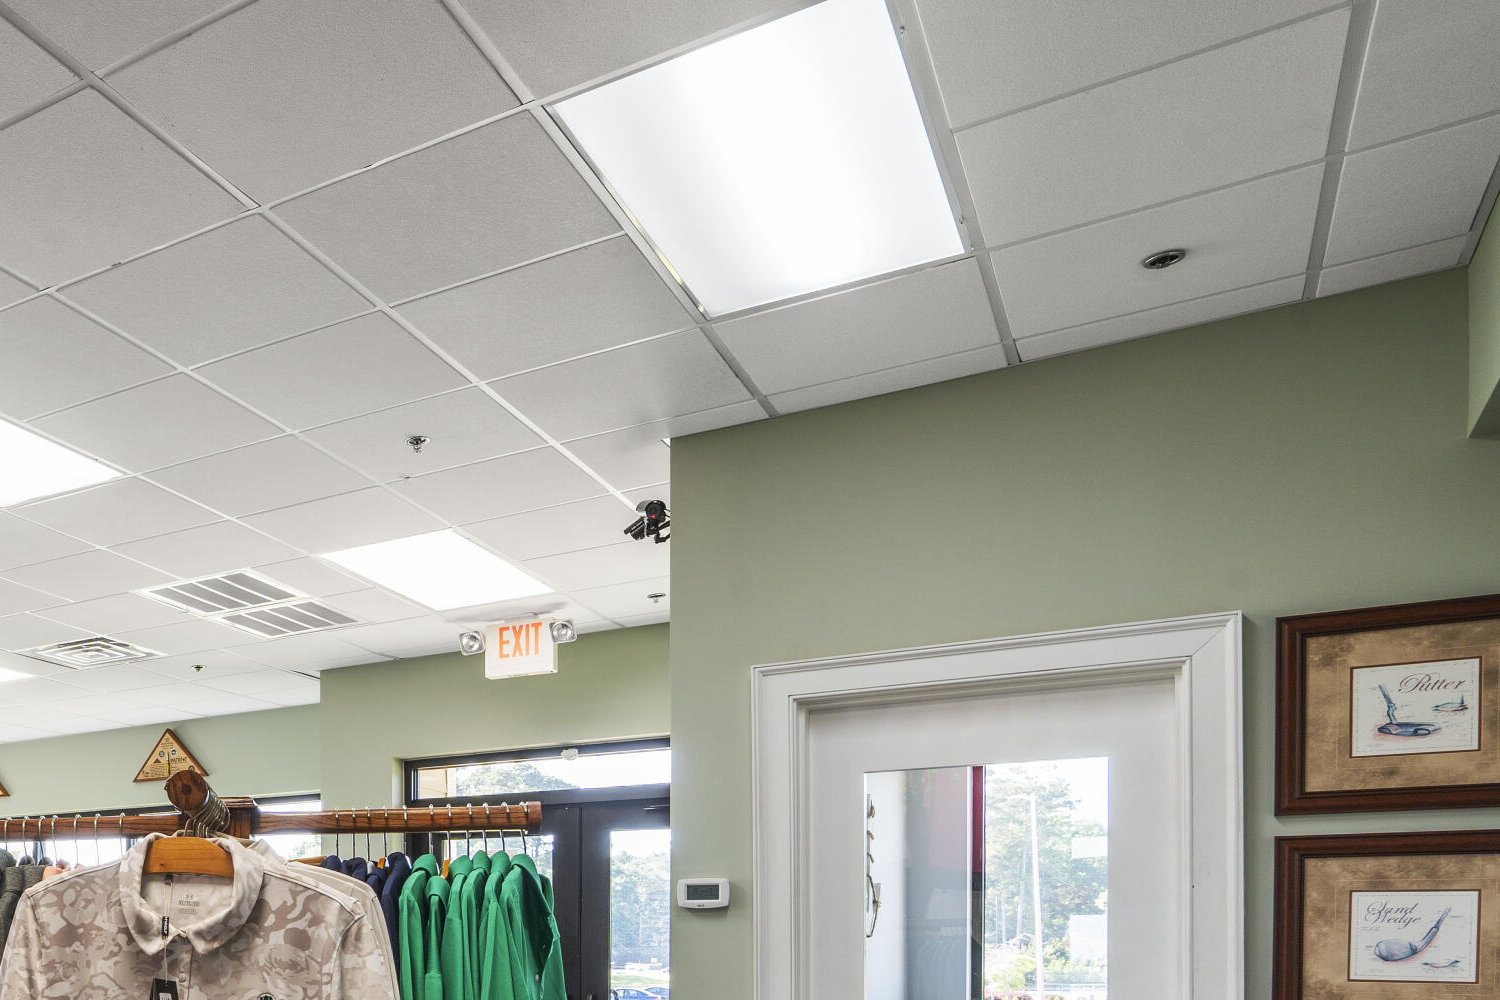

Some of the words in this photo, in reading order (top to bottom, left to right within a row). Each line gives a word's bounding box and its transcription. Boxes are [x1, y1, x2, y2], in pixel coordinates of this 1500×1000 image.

[499, 622, 543, 659] EXIT
[1398, 672, 1466, 693] Putter
[1367, 901, 1419, 914] Sand
[1365, 910, 1421, 930] Wedge
